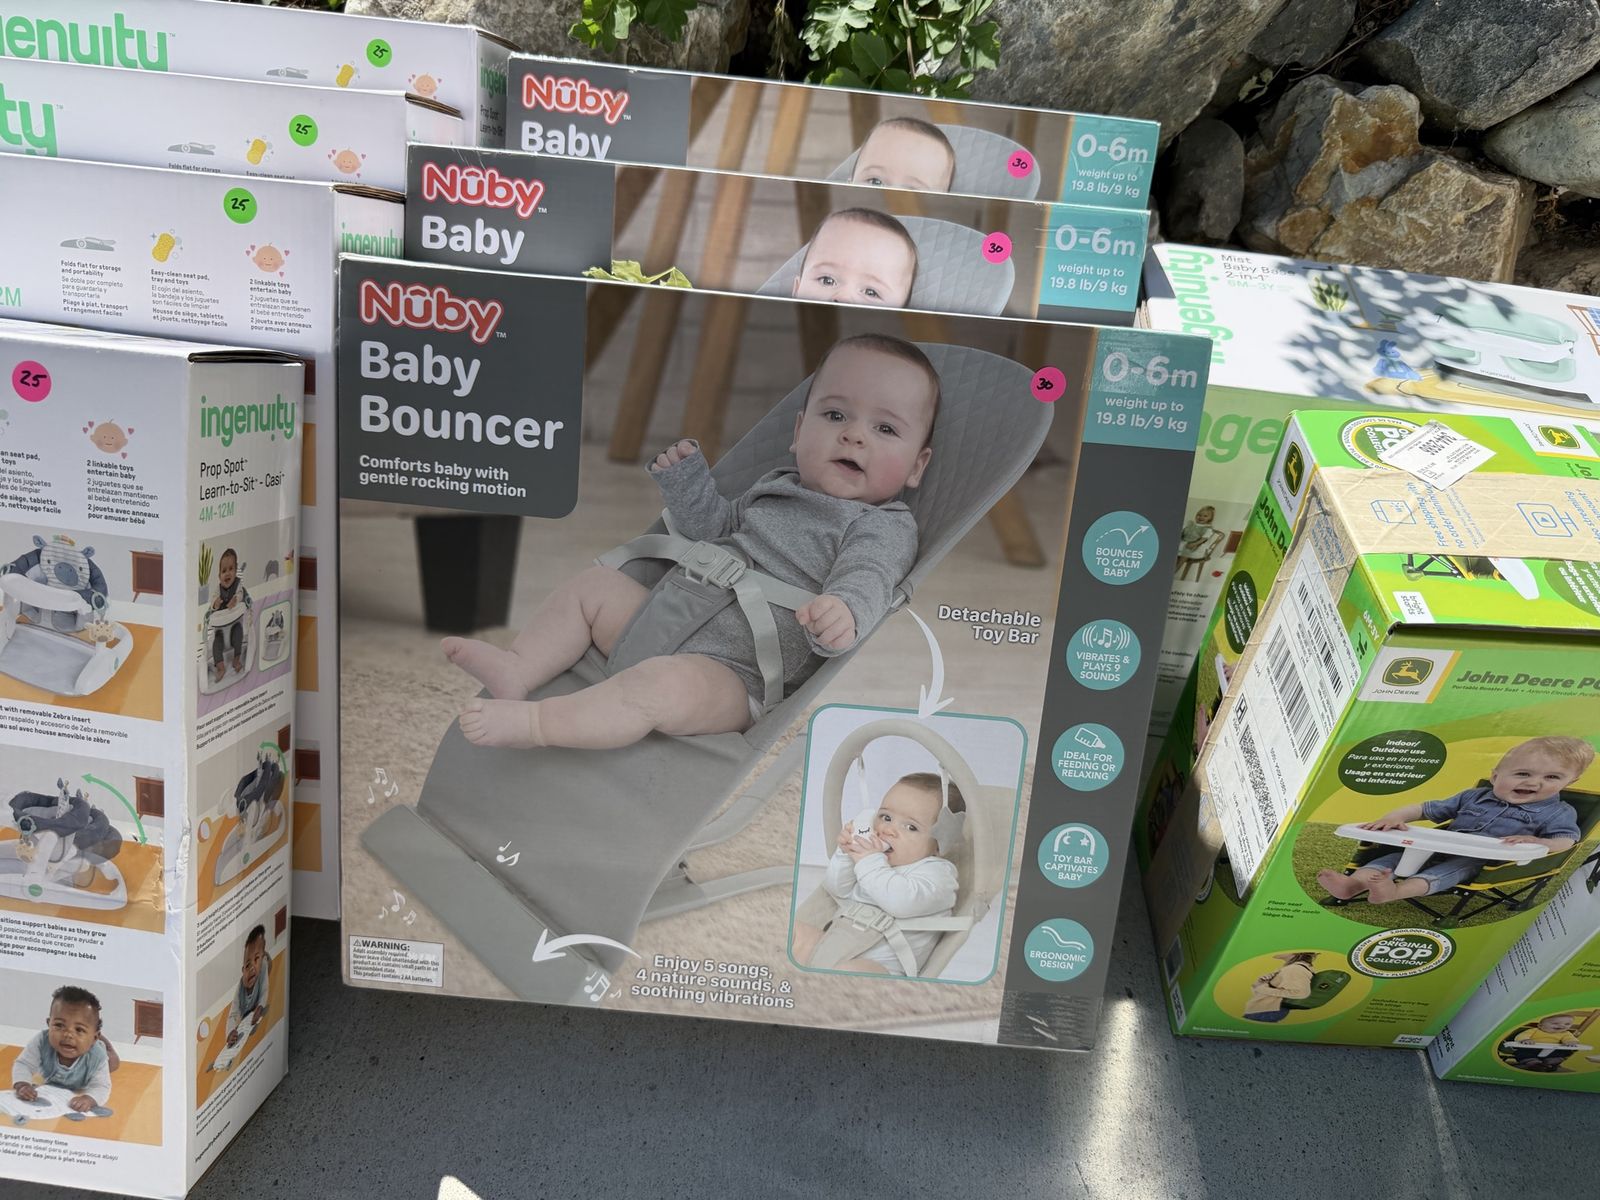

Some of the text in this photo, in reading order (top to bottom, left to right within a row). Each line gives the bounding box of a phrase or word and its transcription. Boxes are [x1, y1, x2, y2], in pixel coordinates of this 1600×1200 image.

[373, 45, 388, 59] 25
[295, 124, 312, 136] 25
[521, 121, 612, 161] Baby
[1077, 134, 1148, 162] 0-6m
[1012, 158, 1027, 169] 30
[1079, 168, 1137, 181] weight up to
[1071, 180, 1140, 197] 19.8 lb/9 kg
[231, 198, 250, 211] 25
[422, 215, 525, 265] Baby
[1055, 224, 1135, 256] 0-6m
[988, 243, 1003, 253] 30
[1058, 263, 1124, 277] weight up to
[1223, 264, 1296, 276] Baby Base
[1050, 276, 1127, 295] 19.8 lb/9 kg
[360, 340, 481, 397] Baby
[1102, 352, 1197, 388] 0-6m
[20, 370, 47, 387] 25
[1036, 377, 1054, 390] 30
[1105, 397, 1184, 412] weight up to
[201, 394, 295, 447] ingenuity
[360, 394, 564, 450] Bouncer
[1096, 411, 1187, 433] 19.8 lb/9 kg
[92, 461, 118, 470] linkable
[119, 464, 134, 472] toys
[200, 462, 222, 479] Prop
[359, 454, 510, 481] Comforts baby with
[87, 469, 136, 480] entertain baby
[359, 471, 527, 498] gentle rocking motion
[132, 510, 159, 518] anneaux
[200, 501, 234, 522] 4M-12M
[1096, 547, 1143, 559] BOUNCES
[1096, 557, 1140, 569] TO CALM
[1103, 568, 1130, 578] BABY
[938, 605, 1041, 627] Detachable
[973, 625, 1039, 644] Toy Bar
[1076, 651, 1130, 664] VIBRATES &
[1082, 662, 1121, 672] PLAYS 9
[1080, 671, 1121, 682] SOUNDS
[1456, 670, 1509, 685] John
[1511, 673, 1575, 688] Deere
[20, 708, 52, 718] removable
[53, 712, 71, 720] Zebra
[72, 715, 91, 724] insert
[1386, 739, 1421, 747] Indoor/
[1063, 750, 1113, 763] IDEAL FOR
[1371, 746, 1409, 754] Outdoor
[1057, 759, 1116, 772] FEEDING OR
[1398, 756, 1440, 764] interiores
[1061, 769, 1110, 781] RELAXING
[1368, 777, 1406, 785] intérieur
[1385, 771, 1426, 779] extérieur
[1052, 854, 1093, 865] TOY BAR
[1044, 862, 1098, 874] CAPTIVATES
[1057, 871, 1083, 881] BABY
[48, 923, 67, 931] babies
[362, 939, 410, 951] WARNING:
[1378, 940, 1433, 949] ORIGINAL
[1029, 950, 1087, 963] ERGONOMIC
[1369, 945, 1433, 960] POP
[654, 955, 773, 979] Enjoy 5 songs,
[1039, 960, 1074, 970] DESIGN
[1366, 957, 1424, 965] COLLECTION
[636, 968, 792, 994] 4 nature sounds, &
[631, 985, 795, 1009] soothing vibrations
